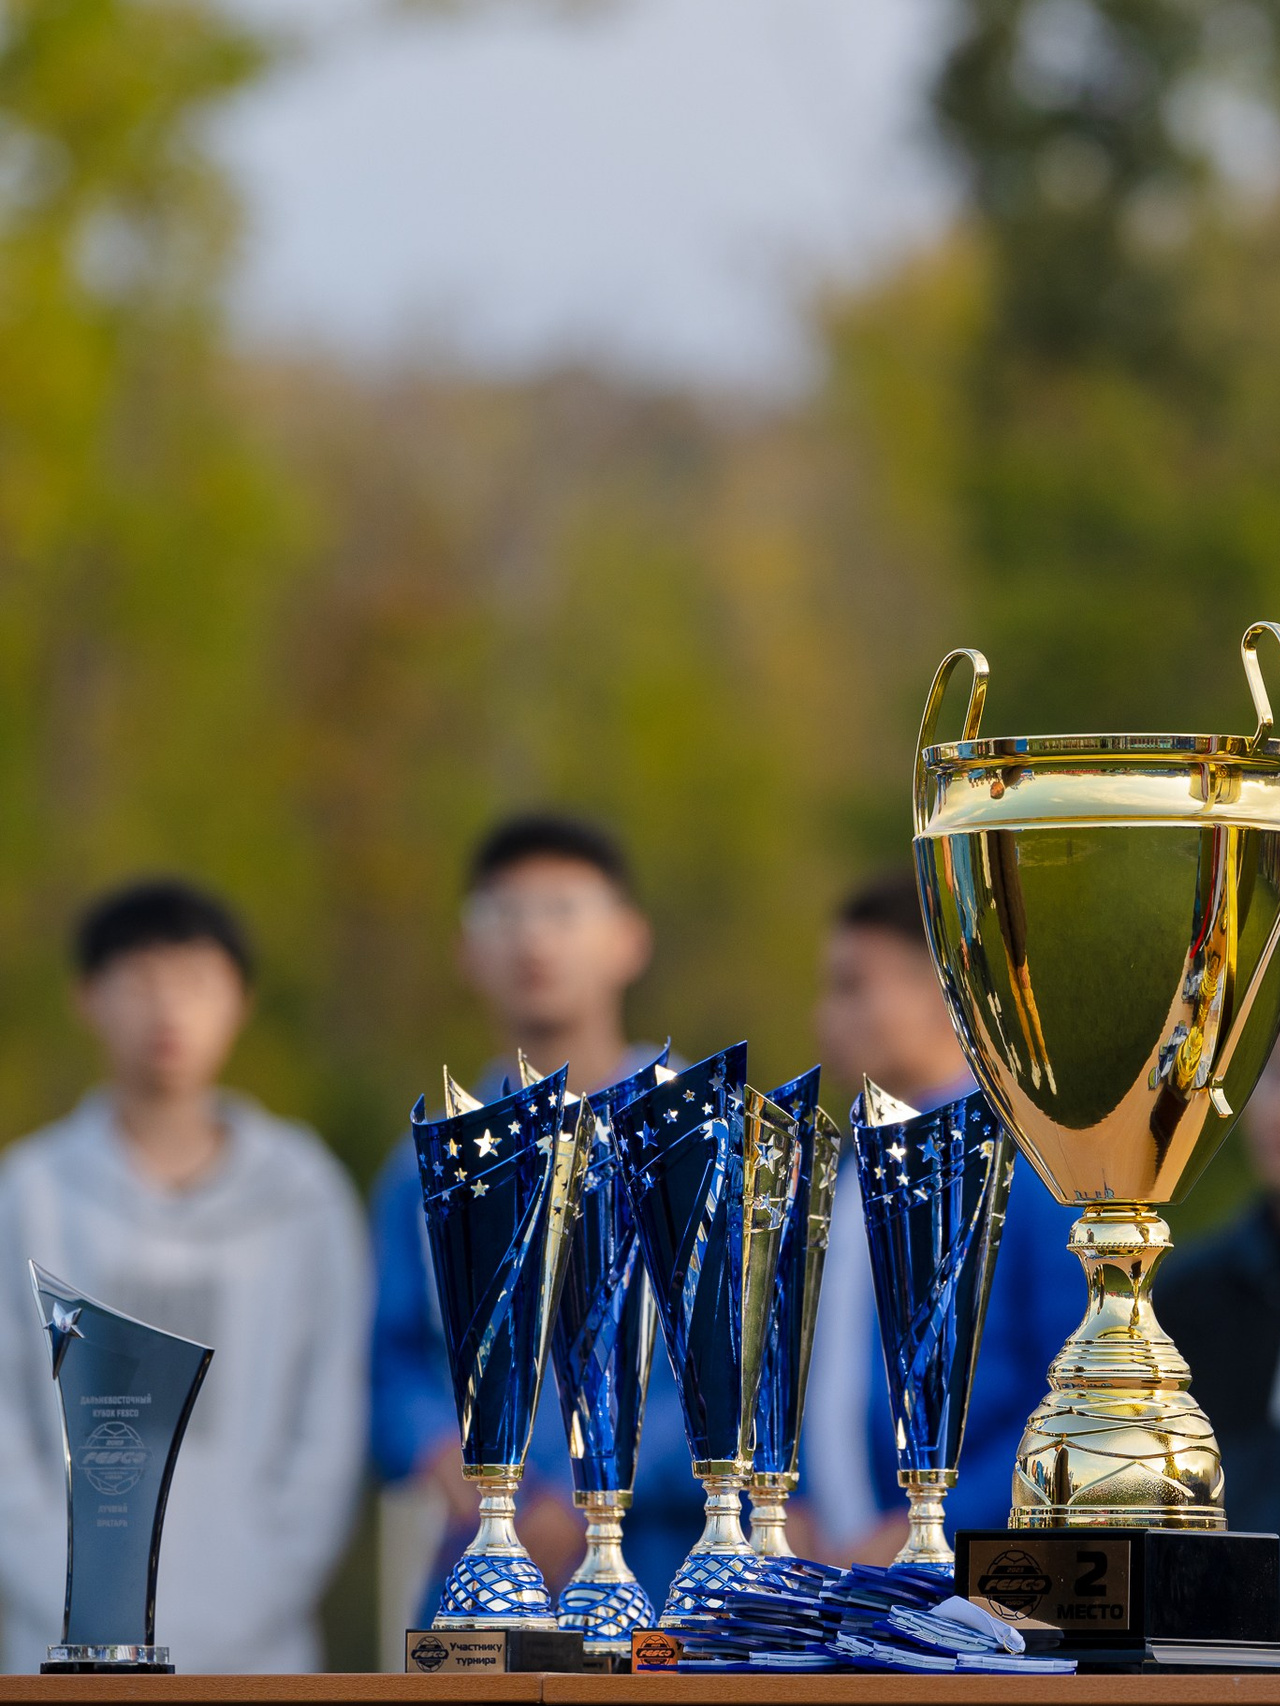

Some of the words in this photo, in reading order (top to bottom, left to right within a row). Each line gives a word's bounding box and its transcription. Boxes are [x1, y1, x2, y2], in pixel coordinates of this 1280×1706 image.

[92, 1409, 115, 1418] КУБОК
[116, 1409, 139, 1418] FESCO
[82, 1452, 146, 1464] FESCO
[1074, 1551, 1108, 1597] 2
[984, 1579, 1046, 1591] FESCO
[1057, 1604, 1124, 1620] МЕСТО
[449, 1642, 503, 1653] Участнику
[455, 1657, 496, 1667] турнира
